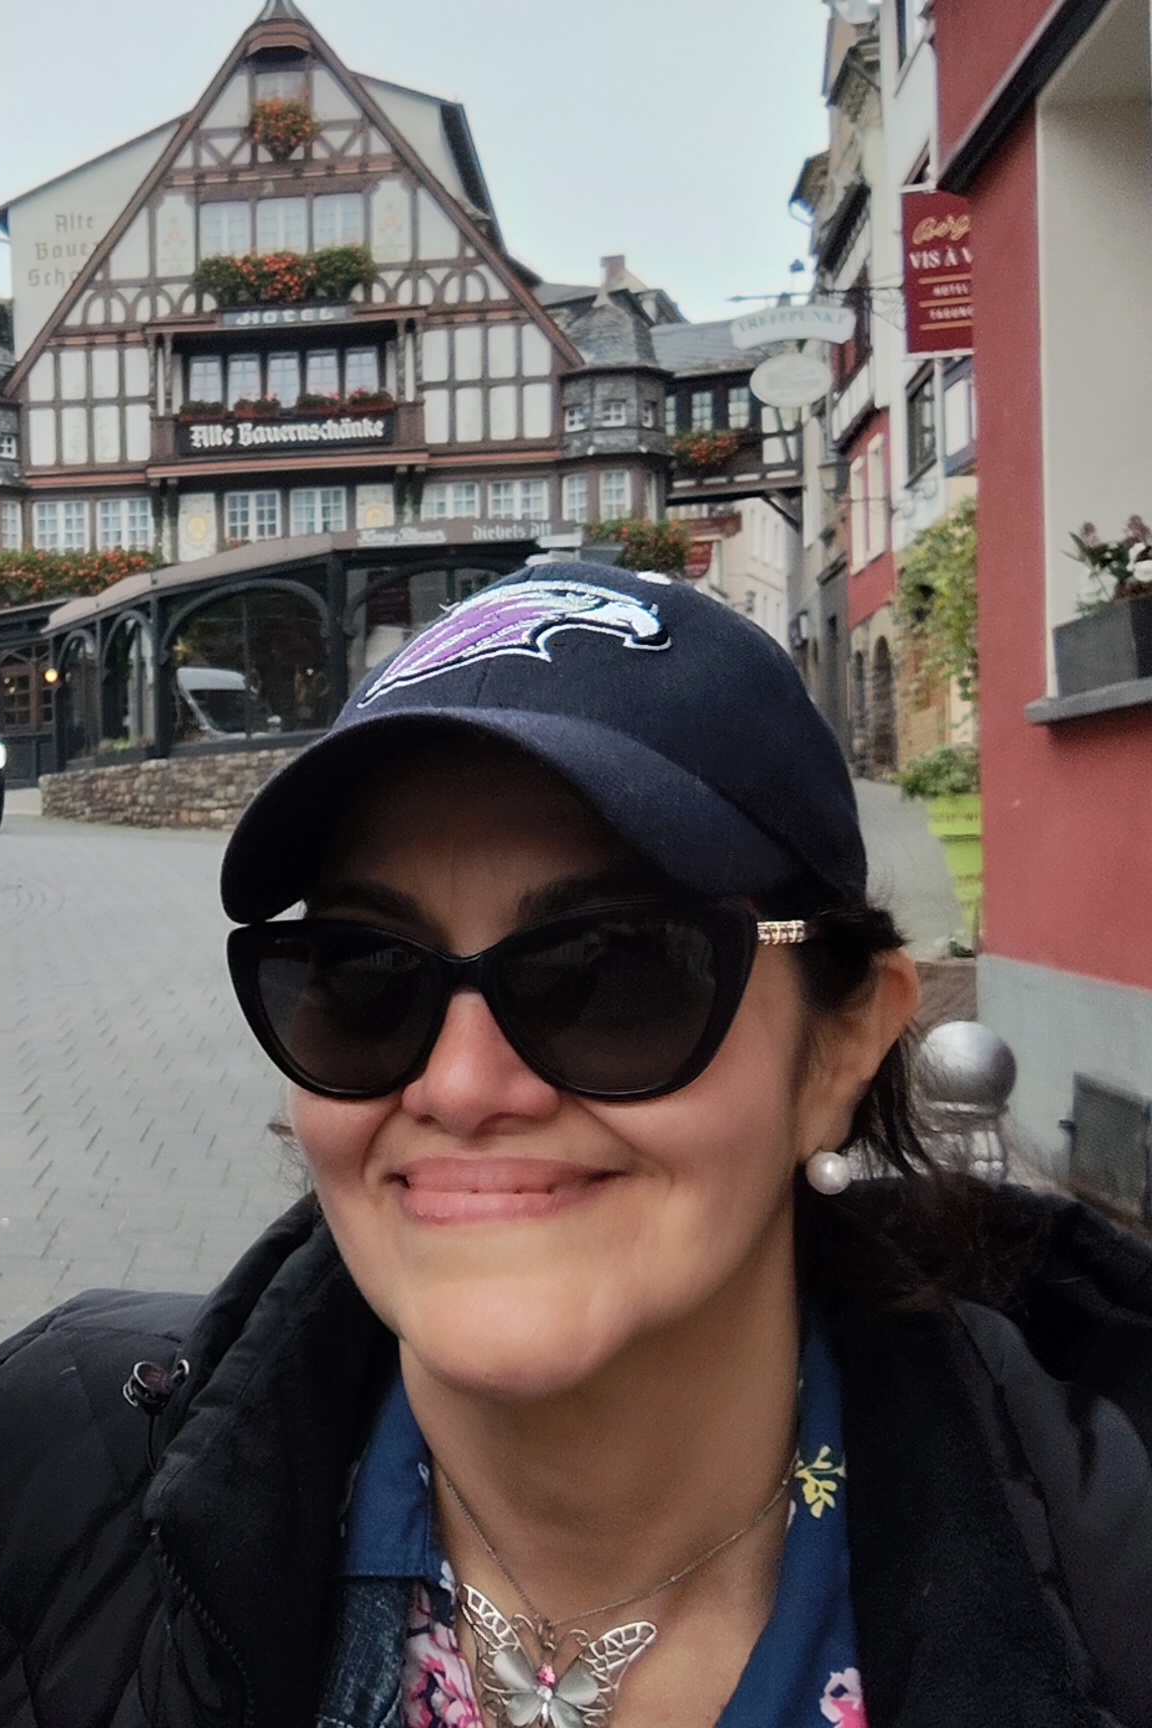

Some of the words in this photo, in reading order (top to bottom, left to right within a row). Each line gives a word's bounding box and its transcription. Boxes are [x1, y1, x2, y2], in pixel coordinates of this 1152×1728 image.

[55, 212, 94, 234] Alte
[909, 251, 941, 269] VIS
[945, 245, 959, 267] À
[236, 308, 334, 326] HOTEL
[190, 424, 235, 448] Alte
[237, 416, 385, 447] Bauernschänke
[472, 523, 527, 541] Diebels
